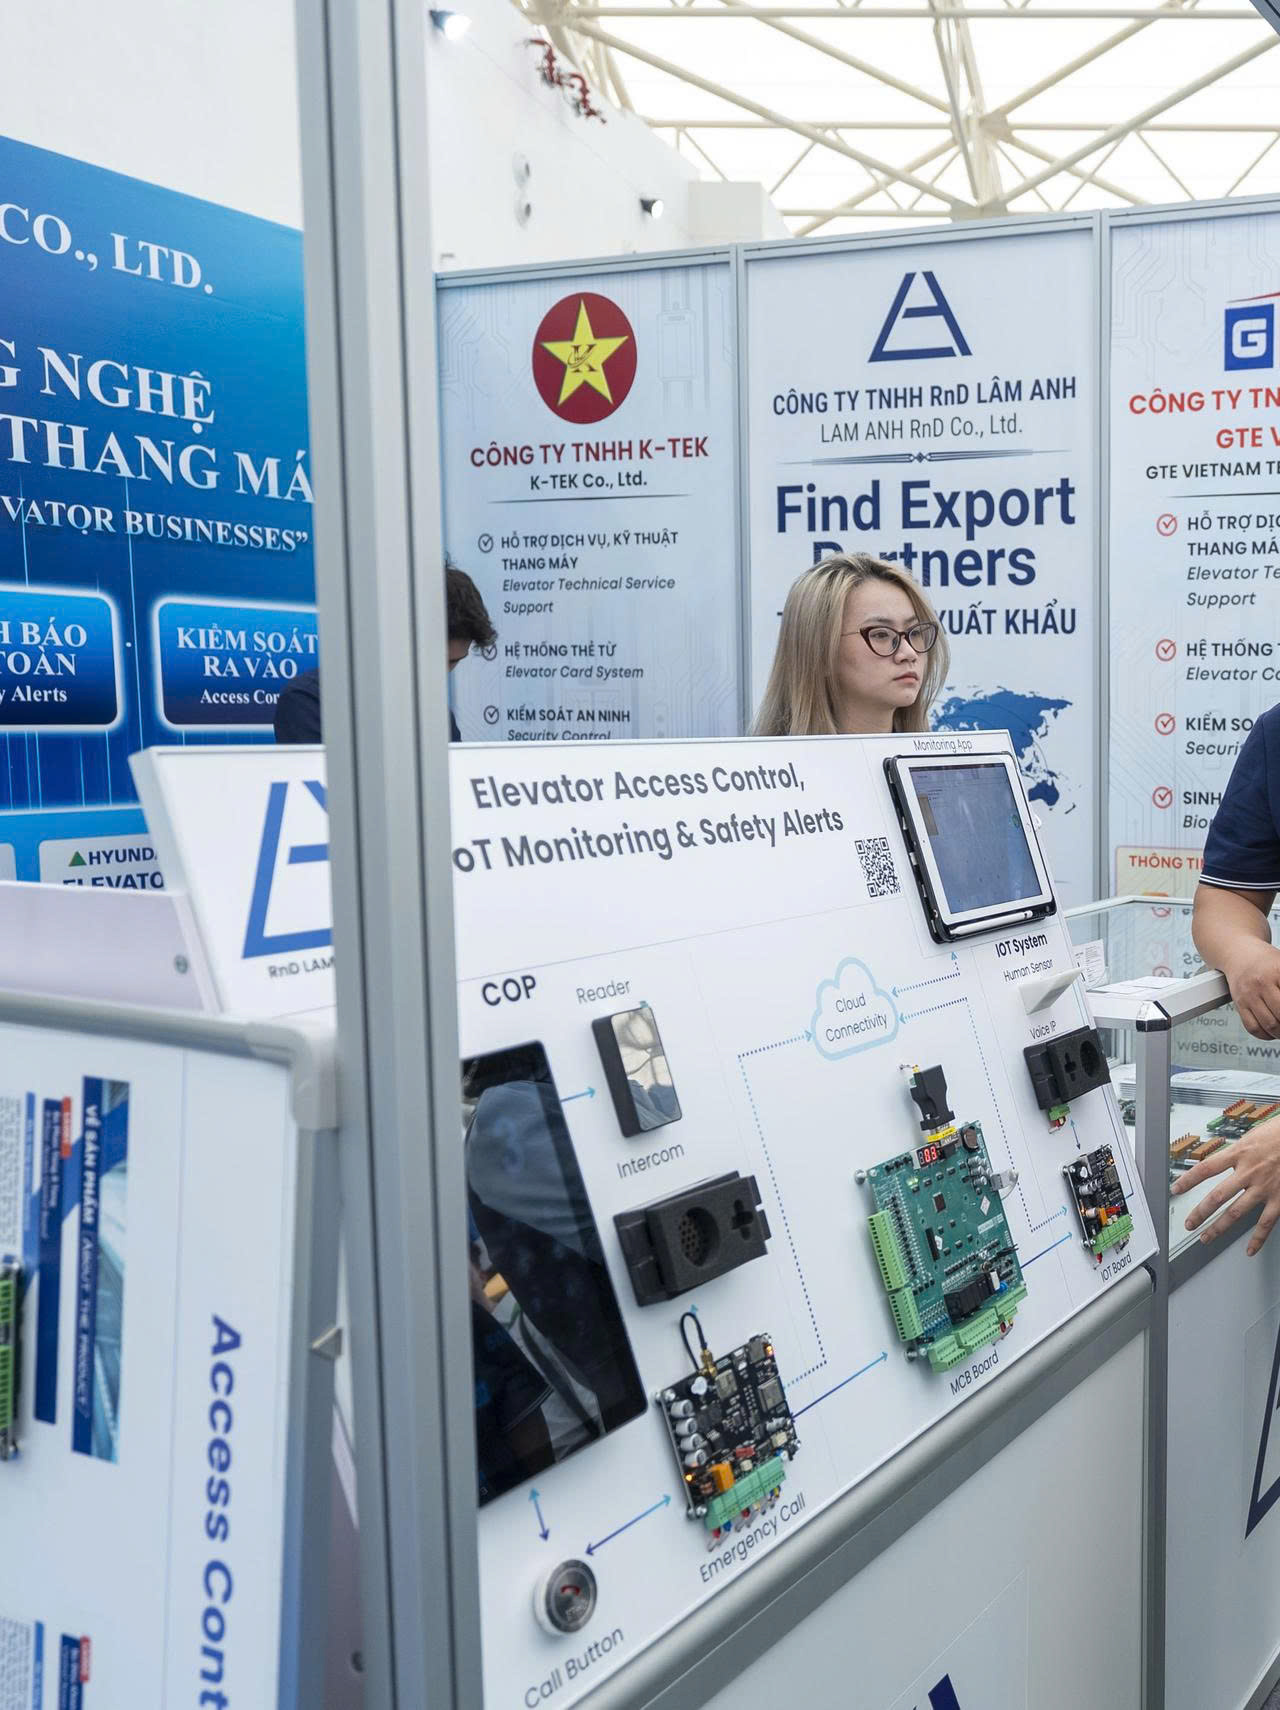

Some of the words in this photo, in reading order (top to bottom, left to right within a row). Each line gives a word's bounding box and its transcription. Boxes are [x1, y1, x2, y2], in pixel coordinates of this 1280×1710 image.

[0, 203, 98, 272] CO.,
[111, 232, 214, 295] LTD.
[38, 347, 215, 434] NGHỆ
[773, 389, 828, 415] CÔNG
[834, 390, 859, 412] TY
[865, 386, 923, 411] TNHH
[930, 384, 969, 407] RnD
[977, 376, 1022, 404] LÂM
[1029, 376, 1076, 401] ANH
[1129, 388, 1205, 415] CÔNG
[1213, 390, 1242, 412] TY
[821, 422, 859, 443] LAM
[864, 419, 903, 441] ANH
[910, 416, 944, 438] RnD
[950, 415, 984, 439] Co.,
[990, 413, 1023, 434] Ltd.
[1216, 427, 1263, 449] GTE
[0, 413, 220, 490] THANG
[470, 441, 534, 467] CÔNG
[540, 442, 566, 465] TY
[572, 440, 633, 463] TNHH
[639, 436, 709, 459] K-TEK
[530, 473, 578, 491] K-TEK
[583, 472, 614, 491] Co.,
[618, 470, 648, 487] Ltd.
[1146, 463, 1178, 480] GTE
[1182, 461, 1262, 479] VIETNAM
[776, 480, 881, 533] Find
[901, 477, 1076, 541] Export
[1187, 510, 1212, 531] HỖ
[1216, 514, 1252, 532] TRỢ
[501, 530, 520, 549] HỖ
[523, 534, 549, 551] TRỢ
[551, 533, 584, 551] DỊCH
[634, 528, 679, 547] THUẬT
[1188, 541, 1247, 557] THANG
[502, 558, 545, 571] THANG
[549, 555, 578, 570] MÁY
[1187, 566, 1260, 581] Elevator
[503, 578, 555, 592] Elevator
[558, 576, 622, 590] Technical
[626, 575, 676, 589] Service
[504, 601, 554, 616] Support
[1187, 591, 1256, 609] Support
[1005, 598, 1076, 635] KHẨU
[20, 616, 88, 648] BÁO
[177, 623, 247, 651] KIỂM
[253, 627, 318, 654] SOÁT
[505, 643, 521, 660] HỆ
[523, 641, 568, 657] THỐNG
[572, 641, 595, 657] THẺ
[598, 642, 617, 657] TỪ
[1186, 639, 1208, 660] HỆ
[1211, 638, 1273, 657] THỐNG
[203, 655, 240, 677] RA
[244, 652, 298, 679] VÀO
[505, 666, 557, 678] Elevator
[560, 665, 593, 678] Card
[596, 667, 644, 681] System
[1186, 666, 1259, 681] Elevator
[11, 685, 68, 702] Alerts
[200, 689, 250, 704] Access
[539, 706, 573, 721] SOÁT
[577, 710, 595, 721] AN
[598, 709, 630, 722] NINH
[1186, 711, 1226, 731] KIỂM
[507, 728, 559, 741] Security
[562, 729, 611, 740] Control
[913, 738, 957, 754] Monitoring
[958, 738, 973, 752] App
[471, 774, 605, 809] Elevator
[614, 768, 708, 800] Access
[712, 762, 805, 793] Control,
[1183, 791, 1221, 805] SINH
[501, 822, 673, 867] Monitoring
[676, 820, 698, 848] &
[700, 811, 777, 847] Safety
[783, 807, 844, 836] Alerts
[89, 847, 157, 866] HYUND
[1129, 853, 1183, 870] THÔNG
[995, 941, 1012, 960] IOT
[1012, 932, 1048, 957] System
[1004, 961, 1030, 983] Human
[1030, 957, 1054, 976] Sensor
[482, 974, 538, 1006] COP
[576, 979, 631, 1005] Reader
[835, 991, 866, 1013] Cloud
[825, 1013, 888, 1042] Connectivity
[1177, 1040, 1242, 1056] website:
[616, 1143, 685, 1180] Intercom
[1100, 1265, 1113, 1283] IOT
[1113, 1251, 1132, 1275] Board
[950, 1372, 974, 1396] MCB
[974, 1351, 1000, 1381] Board
[205, 1313, 242, 1543] Access
[700, 1518, 778, 1584] Emergency
[779, 1491, 807, 1524] Call
[524, 1669, 563, 1710] Call
[566, 1627, 625, 1681] Button
